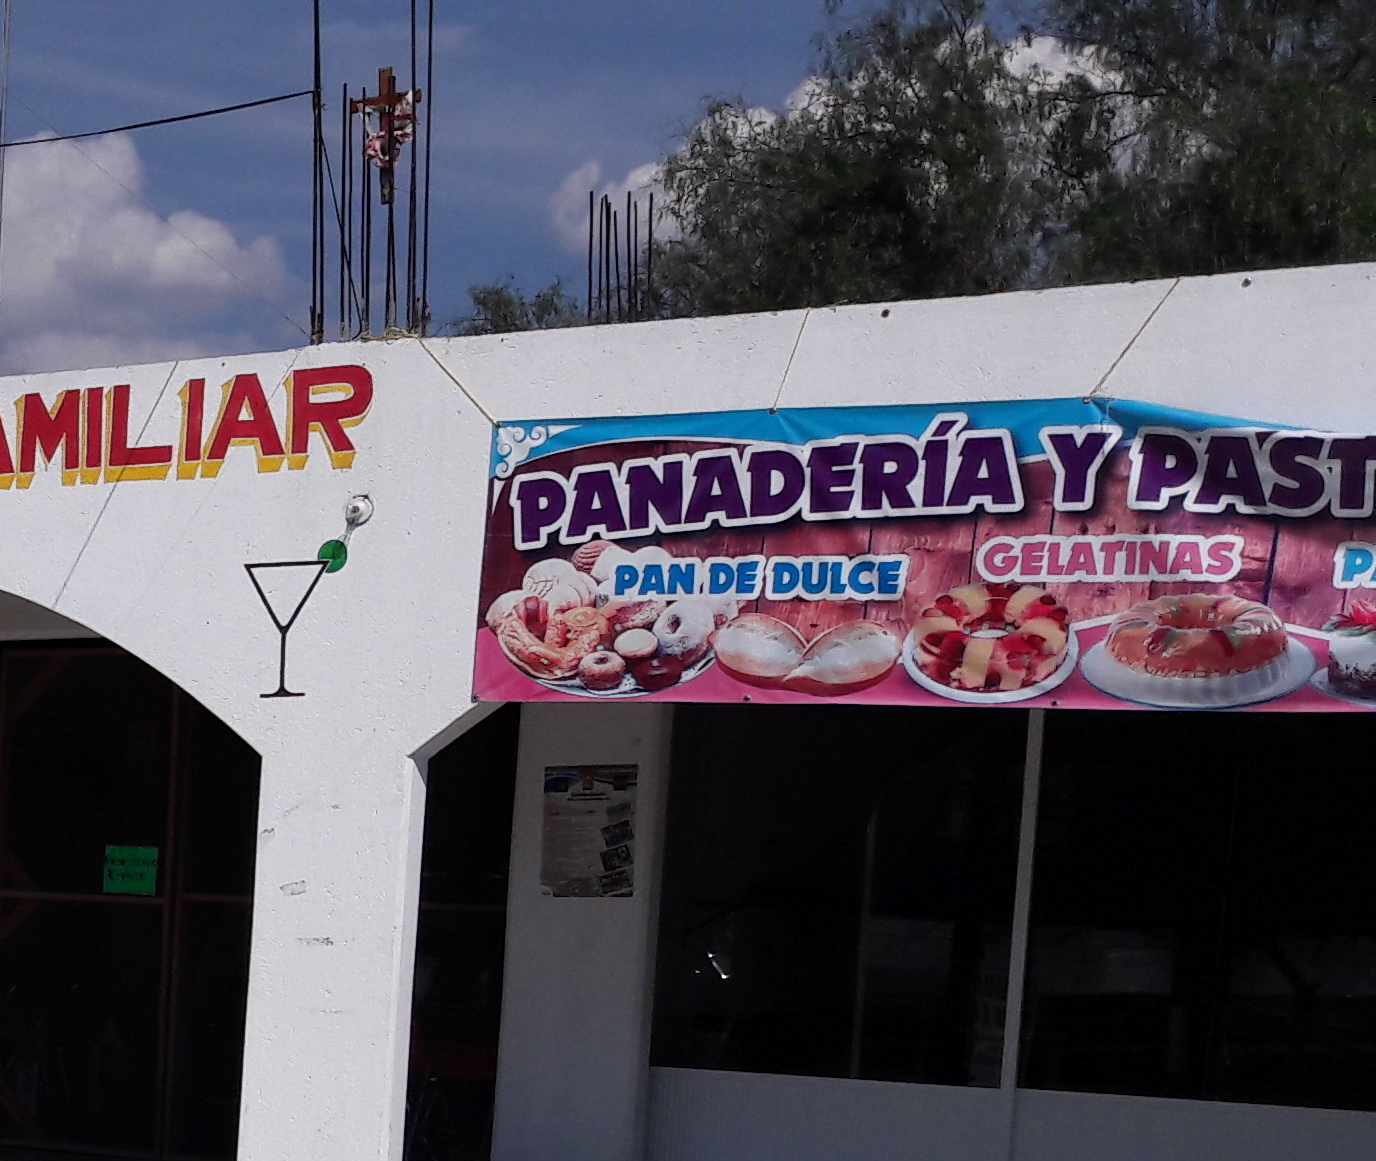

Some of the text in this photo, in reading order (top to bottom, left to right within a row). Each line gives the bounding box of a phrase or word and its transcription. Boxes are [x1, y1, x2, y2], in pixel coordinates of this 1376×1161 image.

[514, 414, 1022, 549] PANADERÍA
[1044, 422, 1119, 511] Y
[612, 555, 907, 598] PAN DE DULCE
[977, 534, 1241, 581] GELATINAS
[1337, 545, 1376, 586] P
